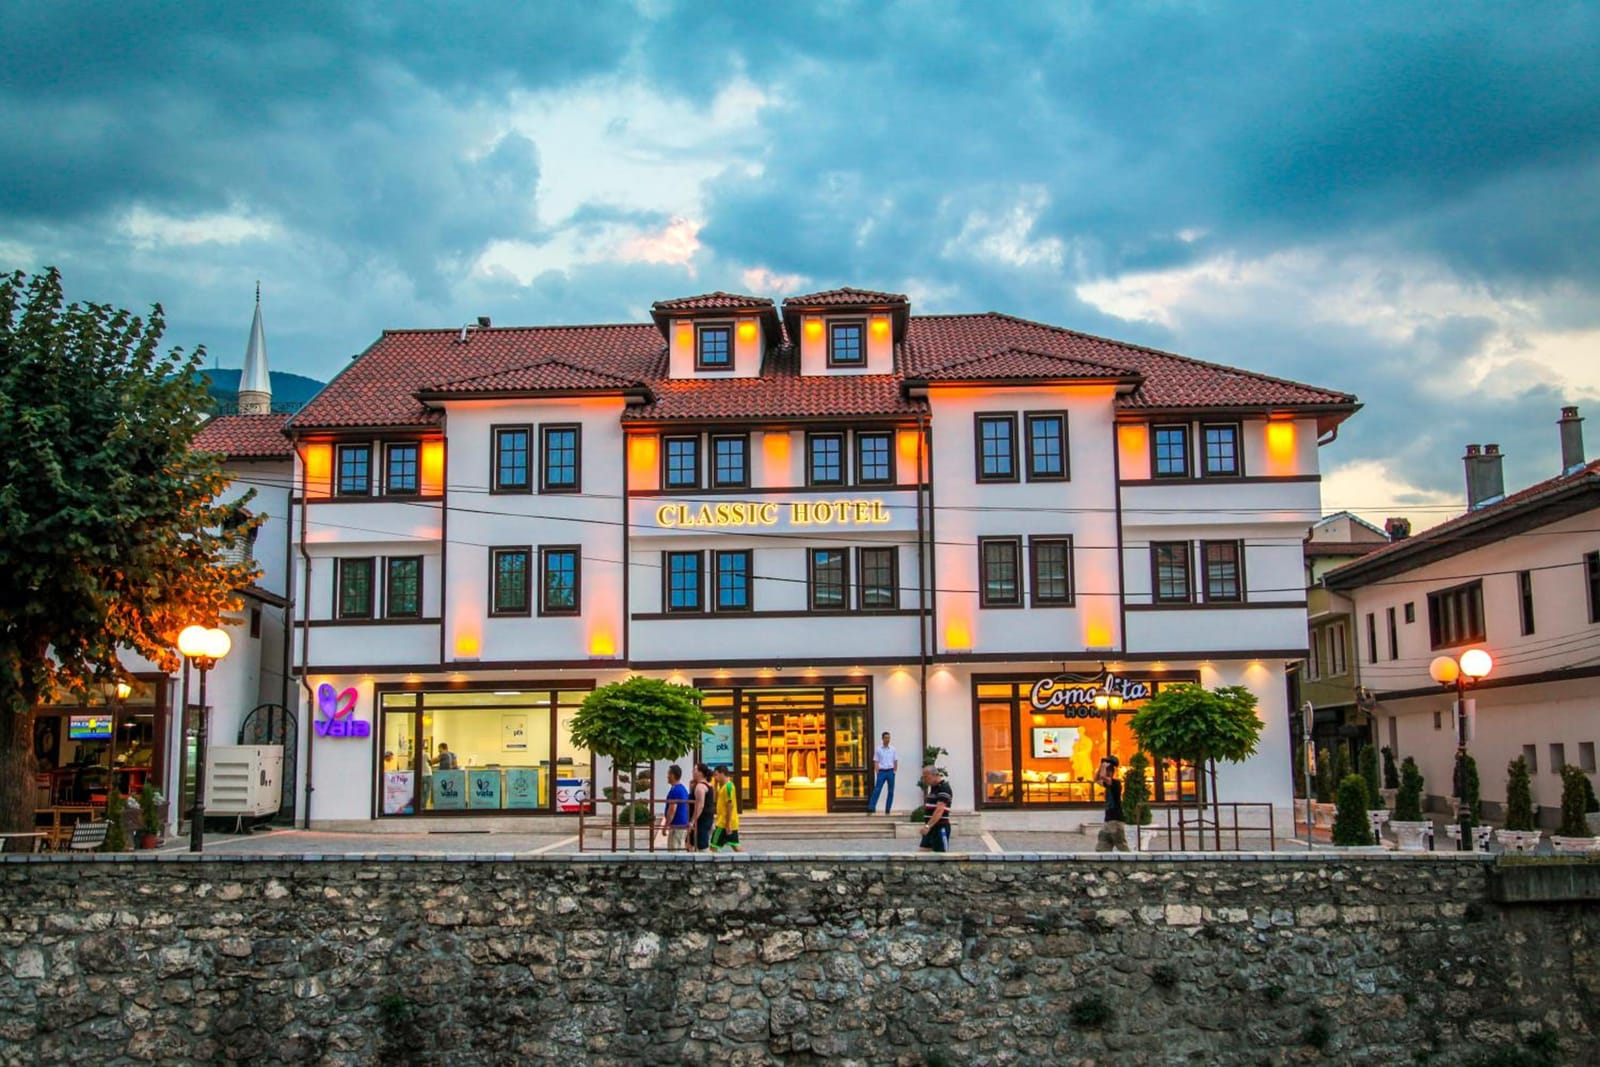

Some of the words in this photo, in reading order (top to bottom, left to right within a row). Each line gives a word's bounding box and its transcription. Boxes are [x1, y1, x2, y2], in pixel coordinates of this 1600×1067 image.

[657, 503, 777, 525] CLASSIC
[792, 501, 889, 524] HOTEL
[1031, 673, 1147, 709] Comota
[1066, 707, 1103, 717] HOM
[314, 711, 370, 737] vala
[440, 789, 459, 797] vala
[475, 789, 494, 797] vala
